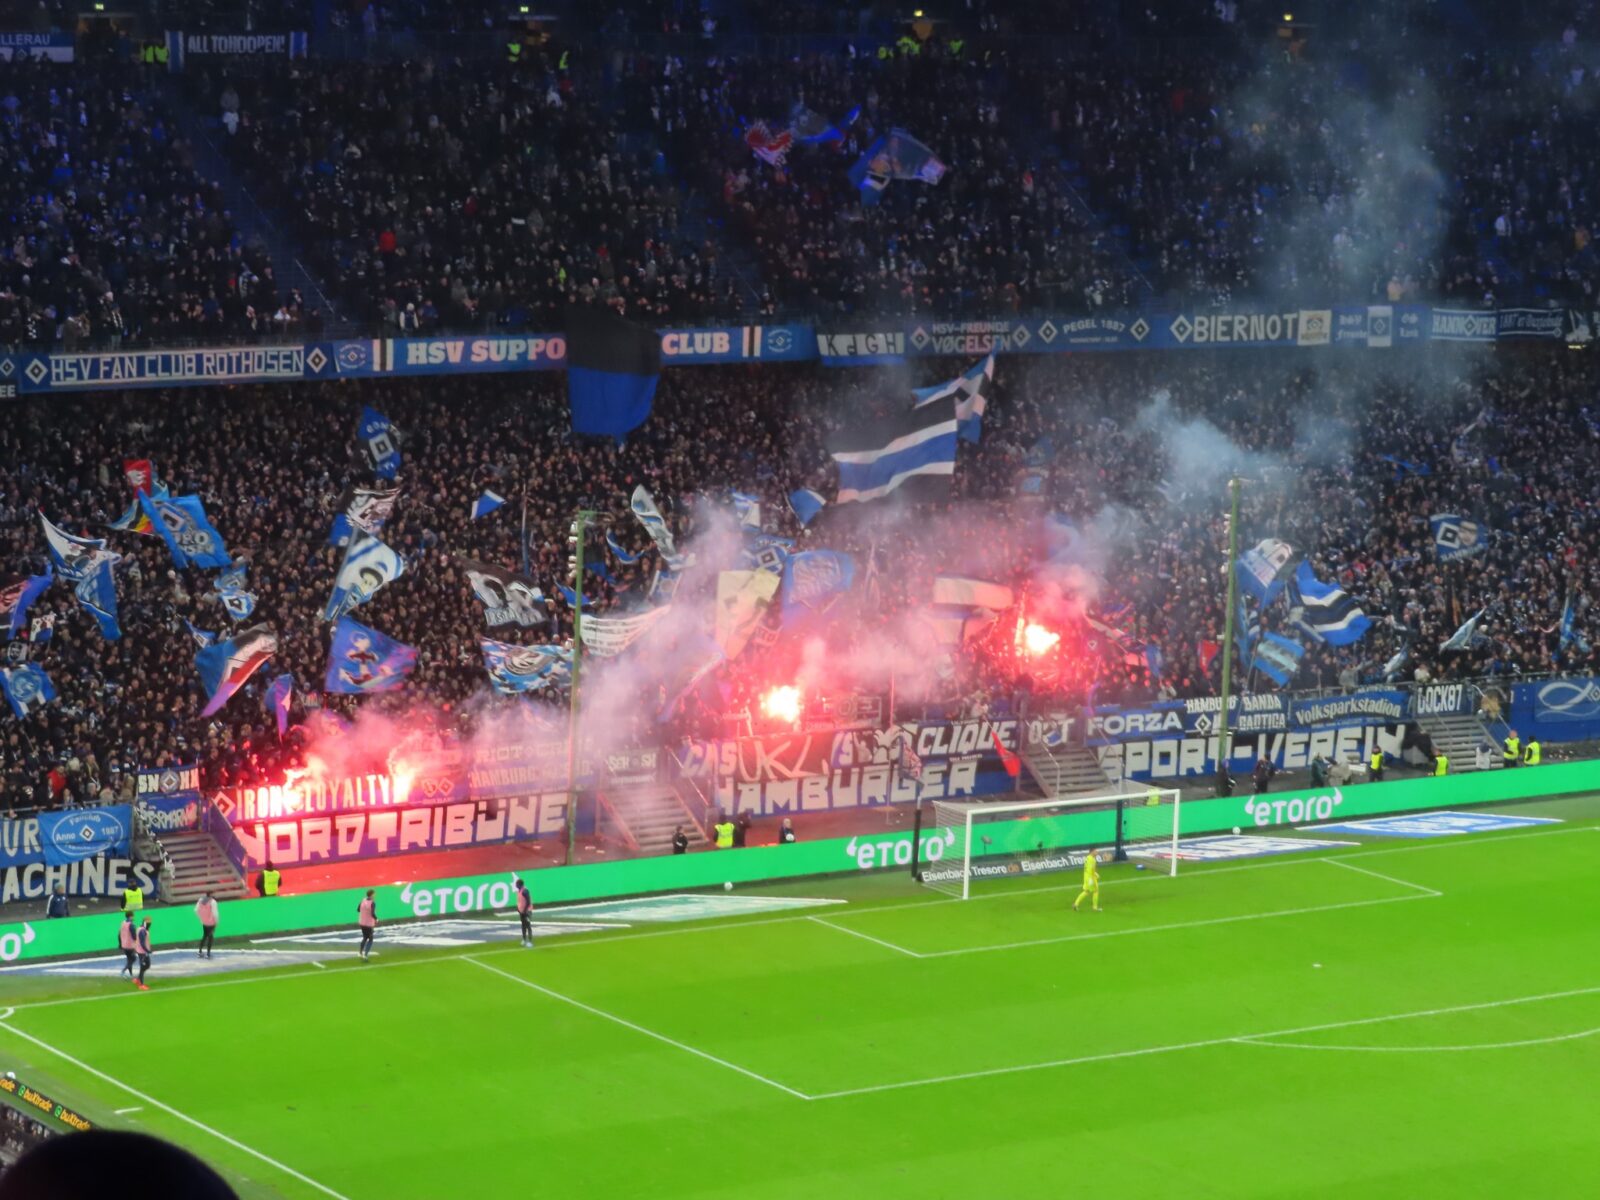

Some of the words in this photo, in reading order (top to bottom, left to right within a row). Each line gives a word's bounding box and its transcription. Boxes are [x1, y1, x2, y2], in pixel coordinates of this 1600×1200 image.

[188, 35, 208, 53] ALL
[1063, 318, 1098, 334] PEGEL
[1193, 312, 1298, 343] BIERNOT
[407, 341, 464, 365] HSV
[471, 337, 566, 363] SUPPO
[661, 331, 730, 355] CLUB
[51, 357, 92, 381] HSV
[100, 355, 137, 380] FAN
[145, 354, 196, 377] CLUB
[203, 350, 304, 376] ROTHOSEN
[1186, 695, 1239, 714] HAMBUG
[1242, 694, 1282, 711] BANDA
[1296, 698, 1401, 725] Volksparkstadion
[1087, 711, 1183, 736] FORZA
[1098, 724, 1405, 780] SPORT-VEREIN
[306, 773, 390, 813] LOYALTY
[56, 832, 76, 842] Anno
[233, 792, 569, 866] NORDTRIBÜNE
[1021, 857, 1069, 871] Eisenbach
